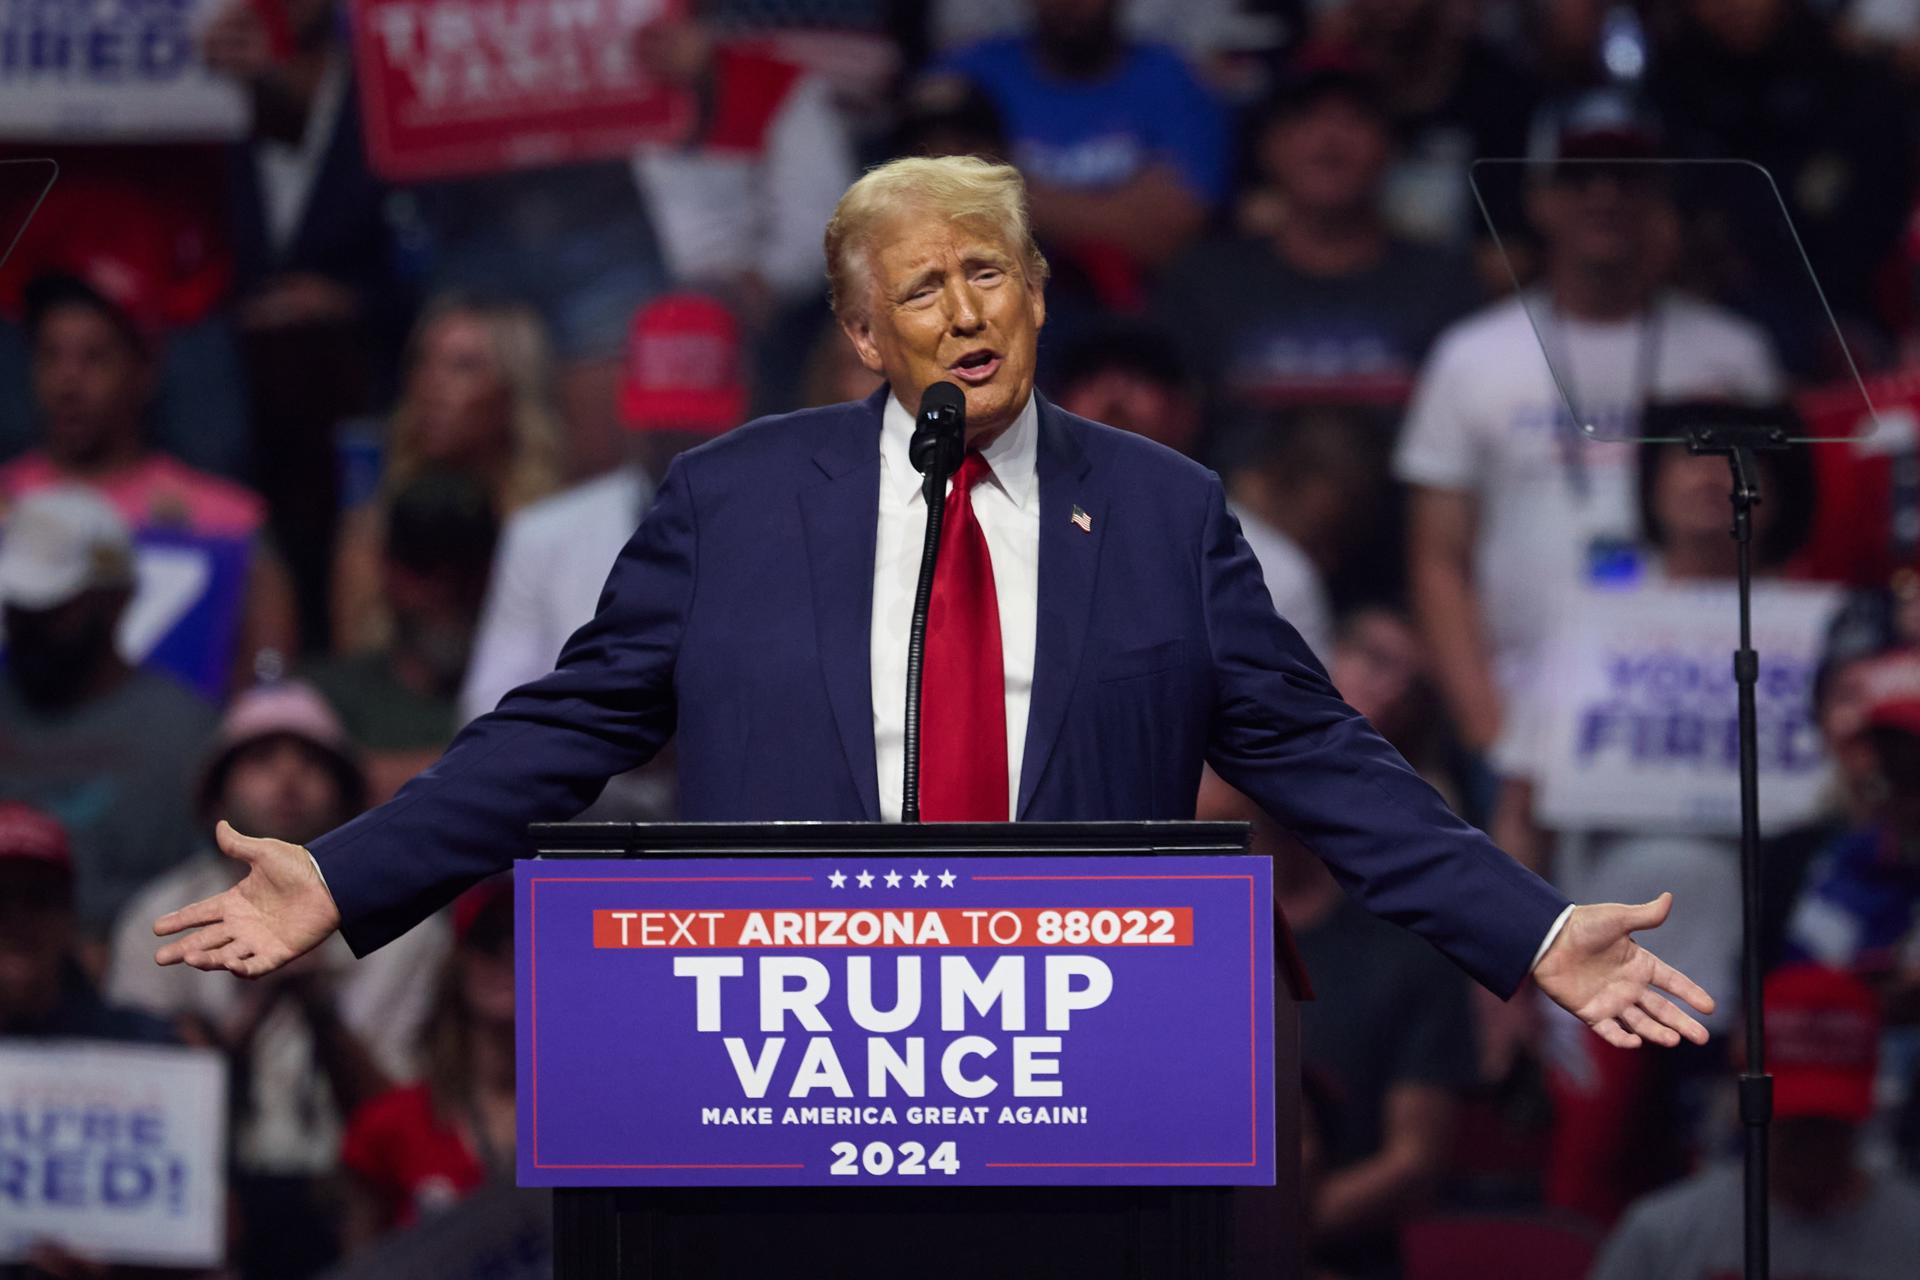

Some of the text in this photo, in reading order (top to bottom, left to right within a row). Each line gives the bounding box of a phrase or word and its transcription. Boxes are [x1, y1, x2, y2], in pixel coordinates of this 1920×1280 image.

[612, 909, 1176, 946] TEXT ARIZONA TO 88022
[673, 954, 1114, 1033] TRUMP
[723, 1035, 1063, 1099] VANCE
[701, 1106, 1088, 1125] MAKE AMERICA GREAT AGAIN!
[829, 1141, 961, 1176] 2024
